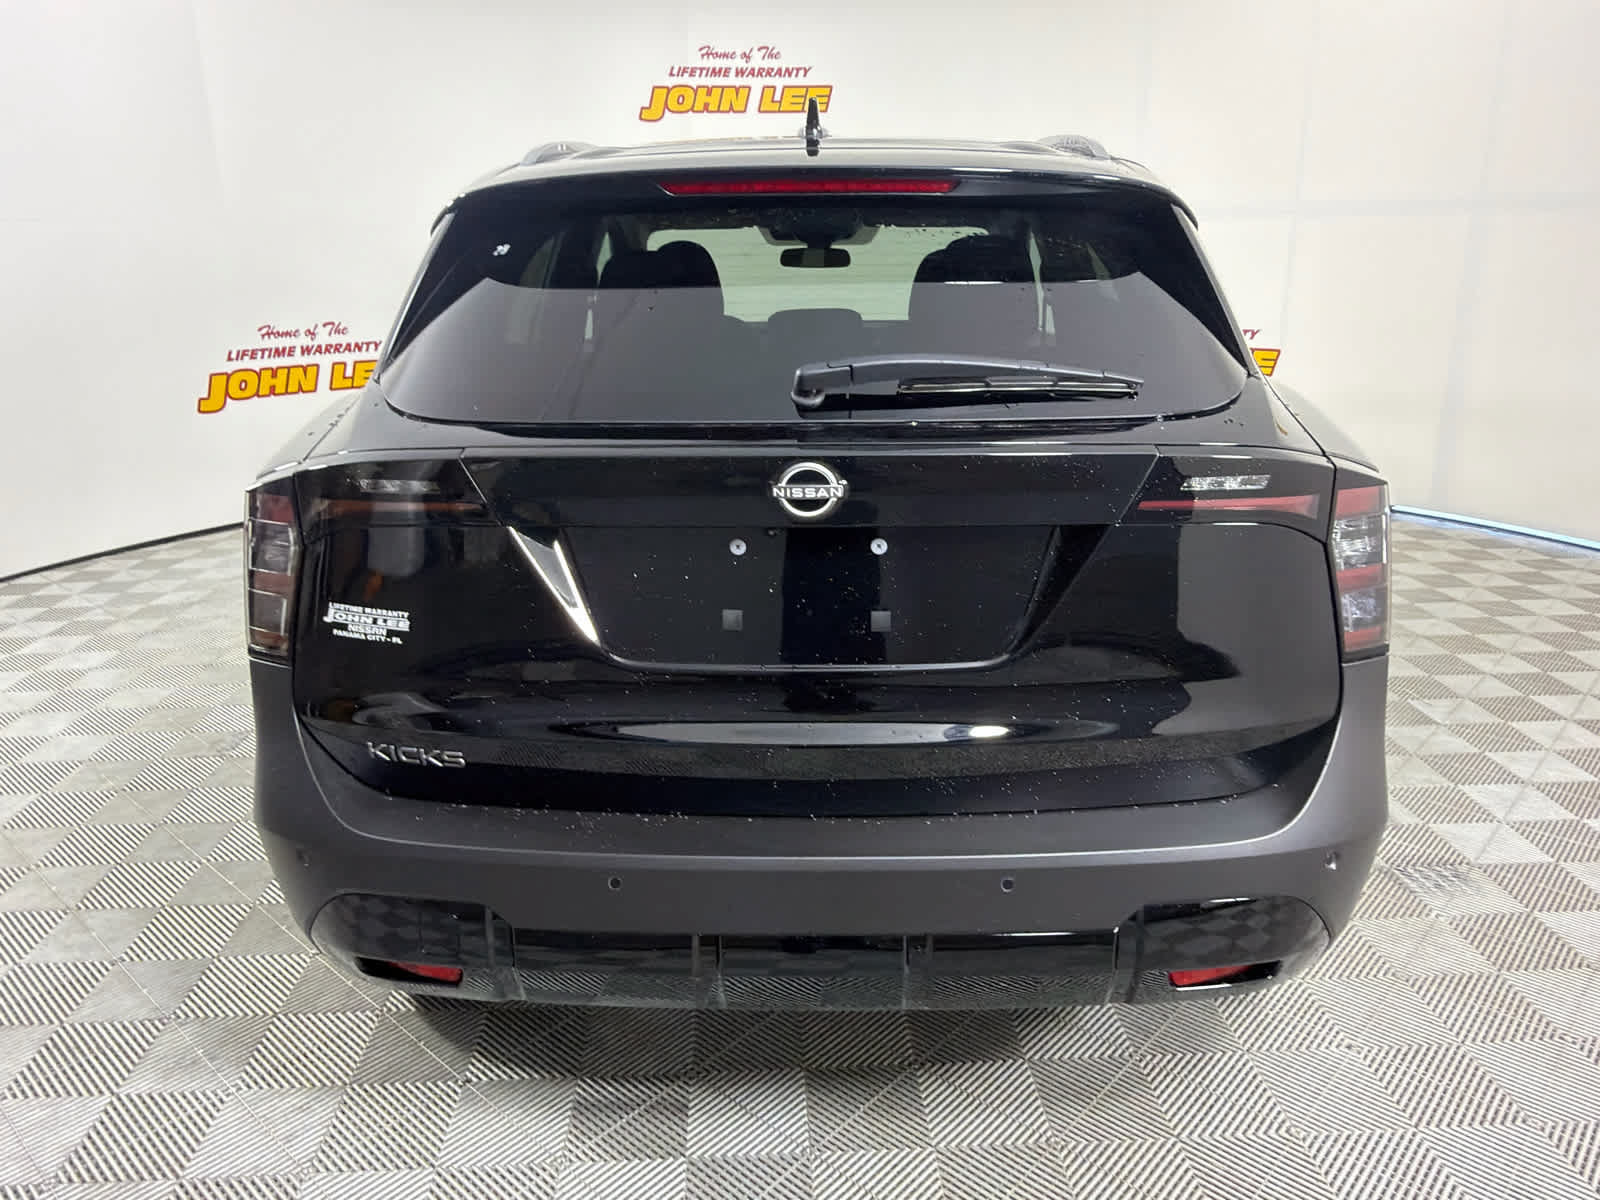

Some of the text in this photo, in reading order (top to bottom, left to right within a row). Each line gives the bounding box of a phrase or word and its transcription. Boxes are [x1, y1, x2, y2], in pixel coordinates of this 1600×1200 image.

[698, 45, 781, 63] Home of The
[668, 66, 812, 78] LIFETIME WARRANTY
[639, 84, 833, 122] JOHN LEE
[257, 321, 348, 341] Home of The
[226, 340, 382, 362] LIFETIME WARRANTY
[197, 359, 379, 414] JOHN LE
[772, 487, 844, 498] NISSAN
[322, 608, 411, 630] JOHN LEE
[328, 601, 410, 619] LIFETIME WARRANTY
[332, 629, 366, 640] PANAMA
[366, 634, 386, 642] CITY
[392, 636, 403, 645] FL
[347, 624, 388, 636] NISSAN
[366, 742, 466, 768] KICKS
